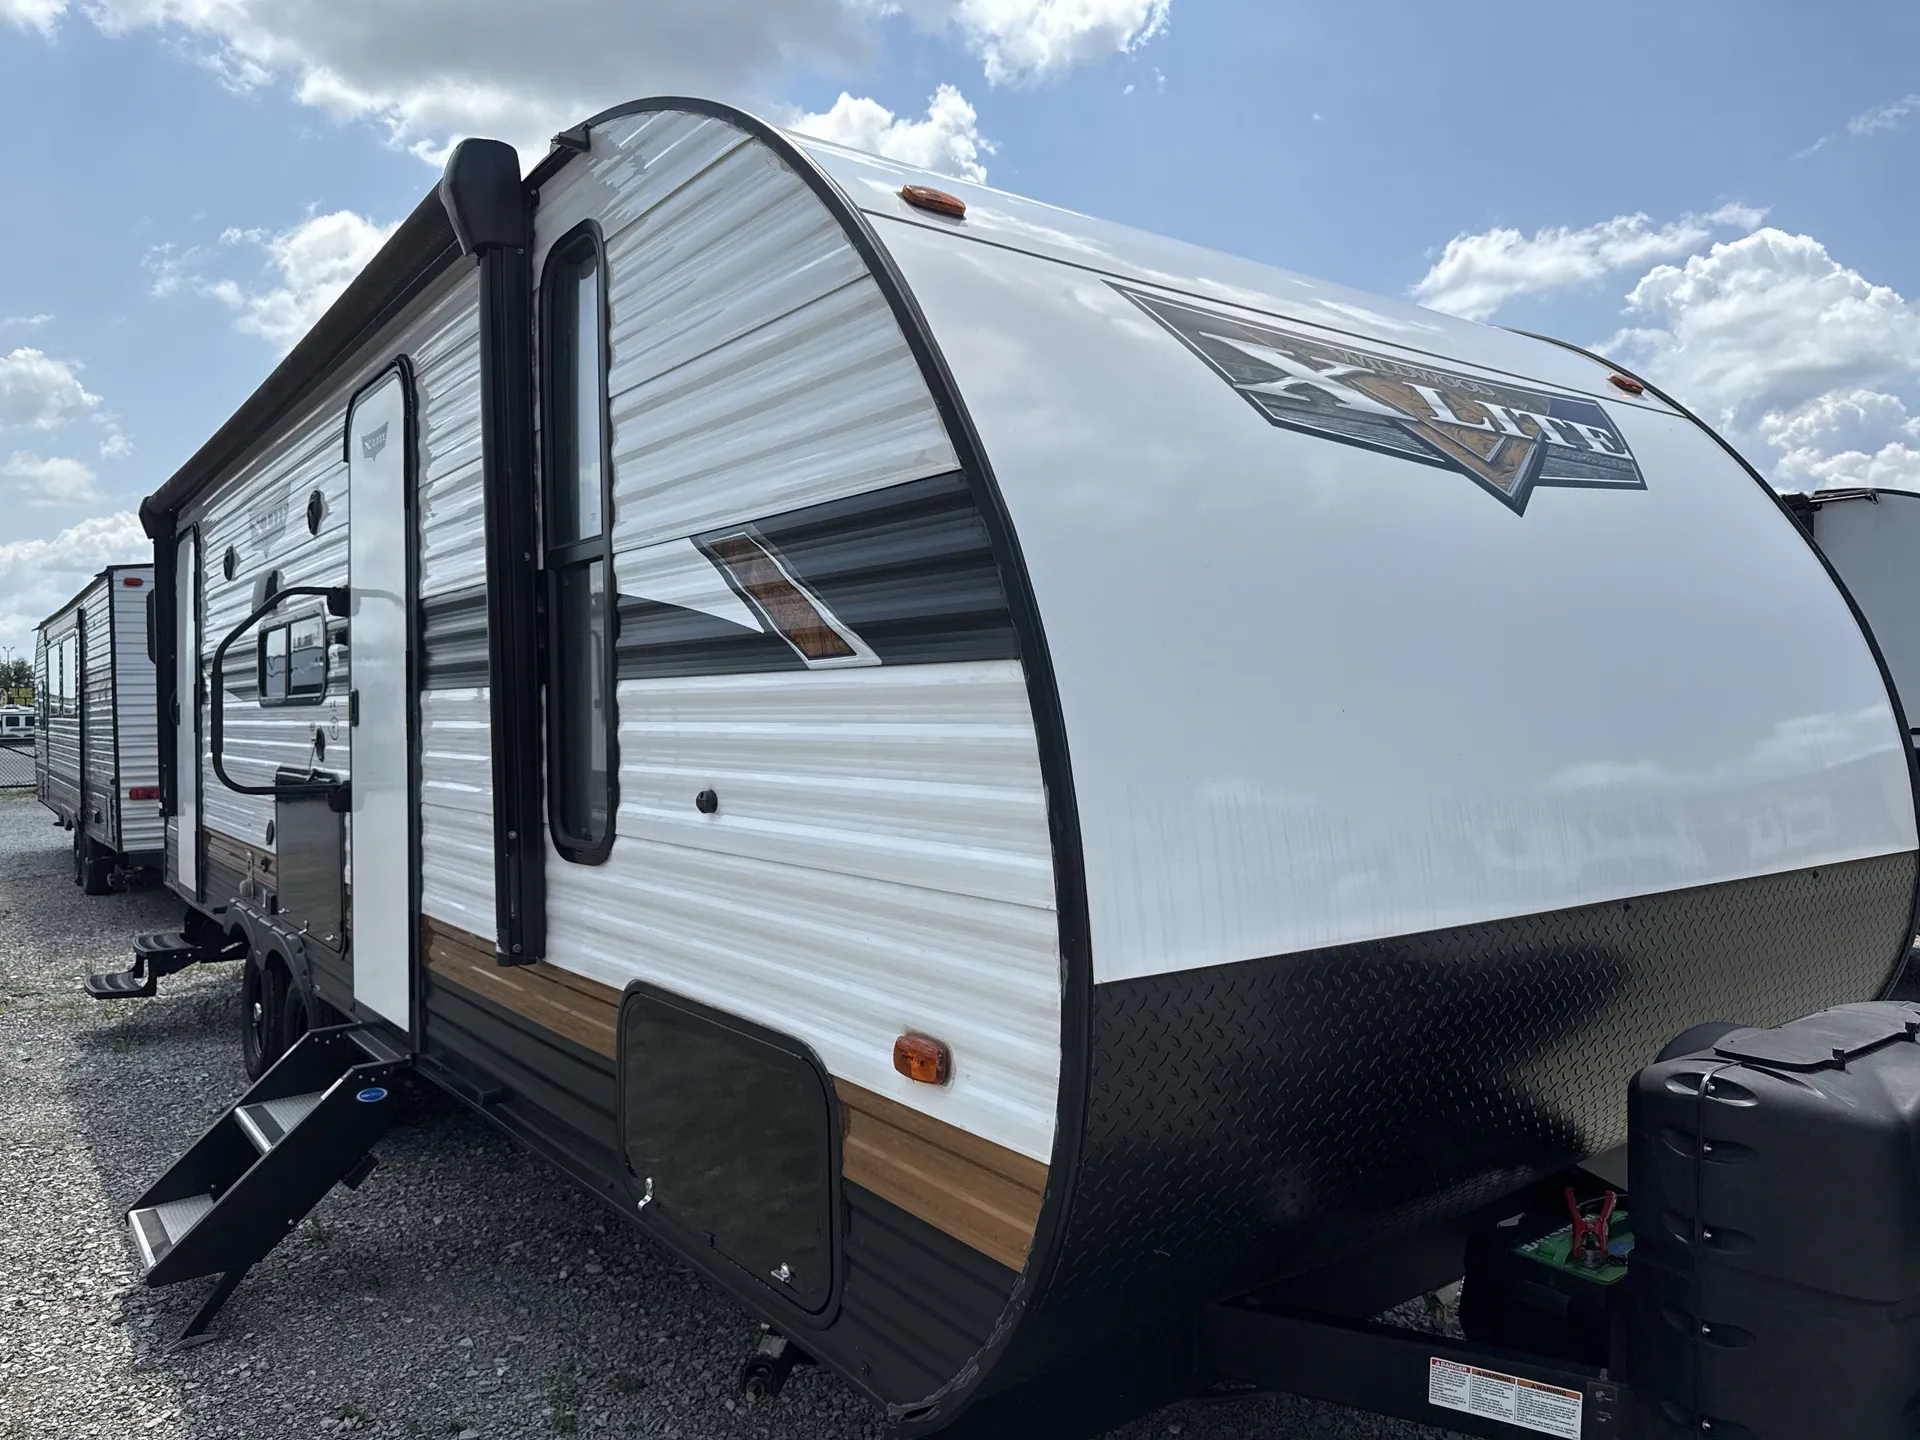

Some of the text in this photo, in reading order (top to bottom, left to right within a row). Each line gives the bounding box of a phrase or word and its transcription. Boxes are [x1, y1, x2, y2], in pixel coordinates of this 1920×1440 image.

[1327, 346, 1495, 397] WILDWOOD
[1198, 331, 1634, 461] X LITE
[1441, 1361, 1467, 1372] DANGER
[1481, 1371, 1510, 1383] WARNING
[1536, 1385, 1567, 1397] WARNING
